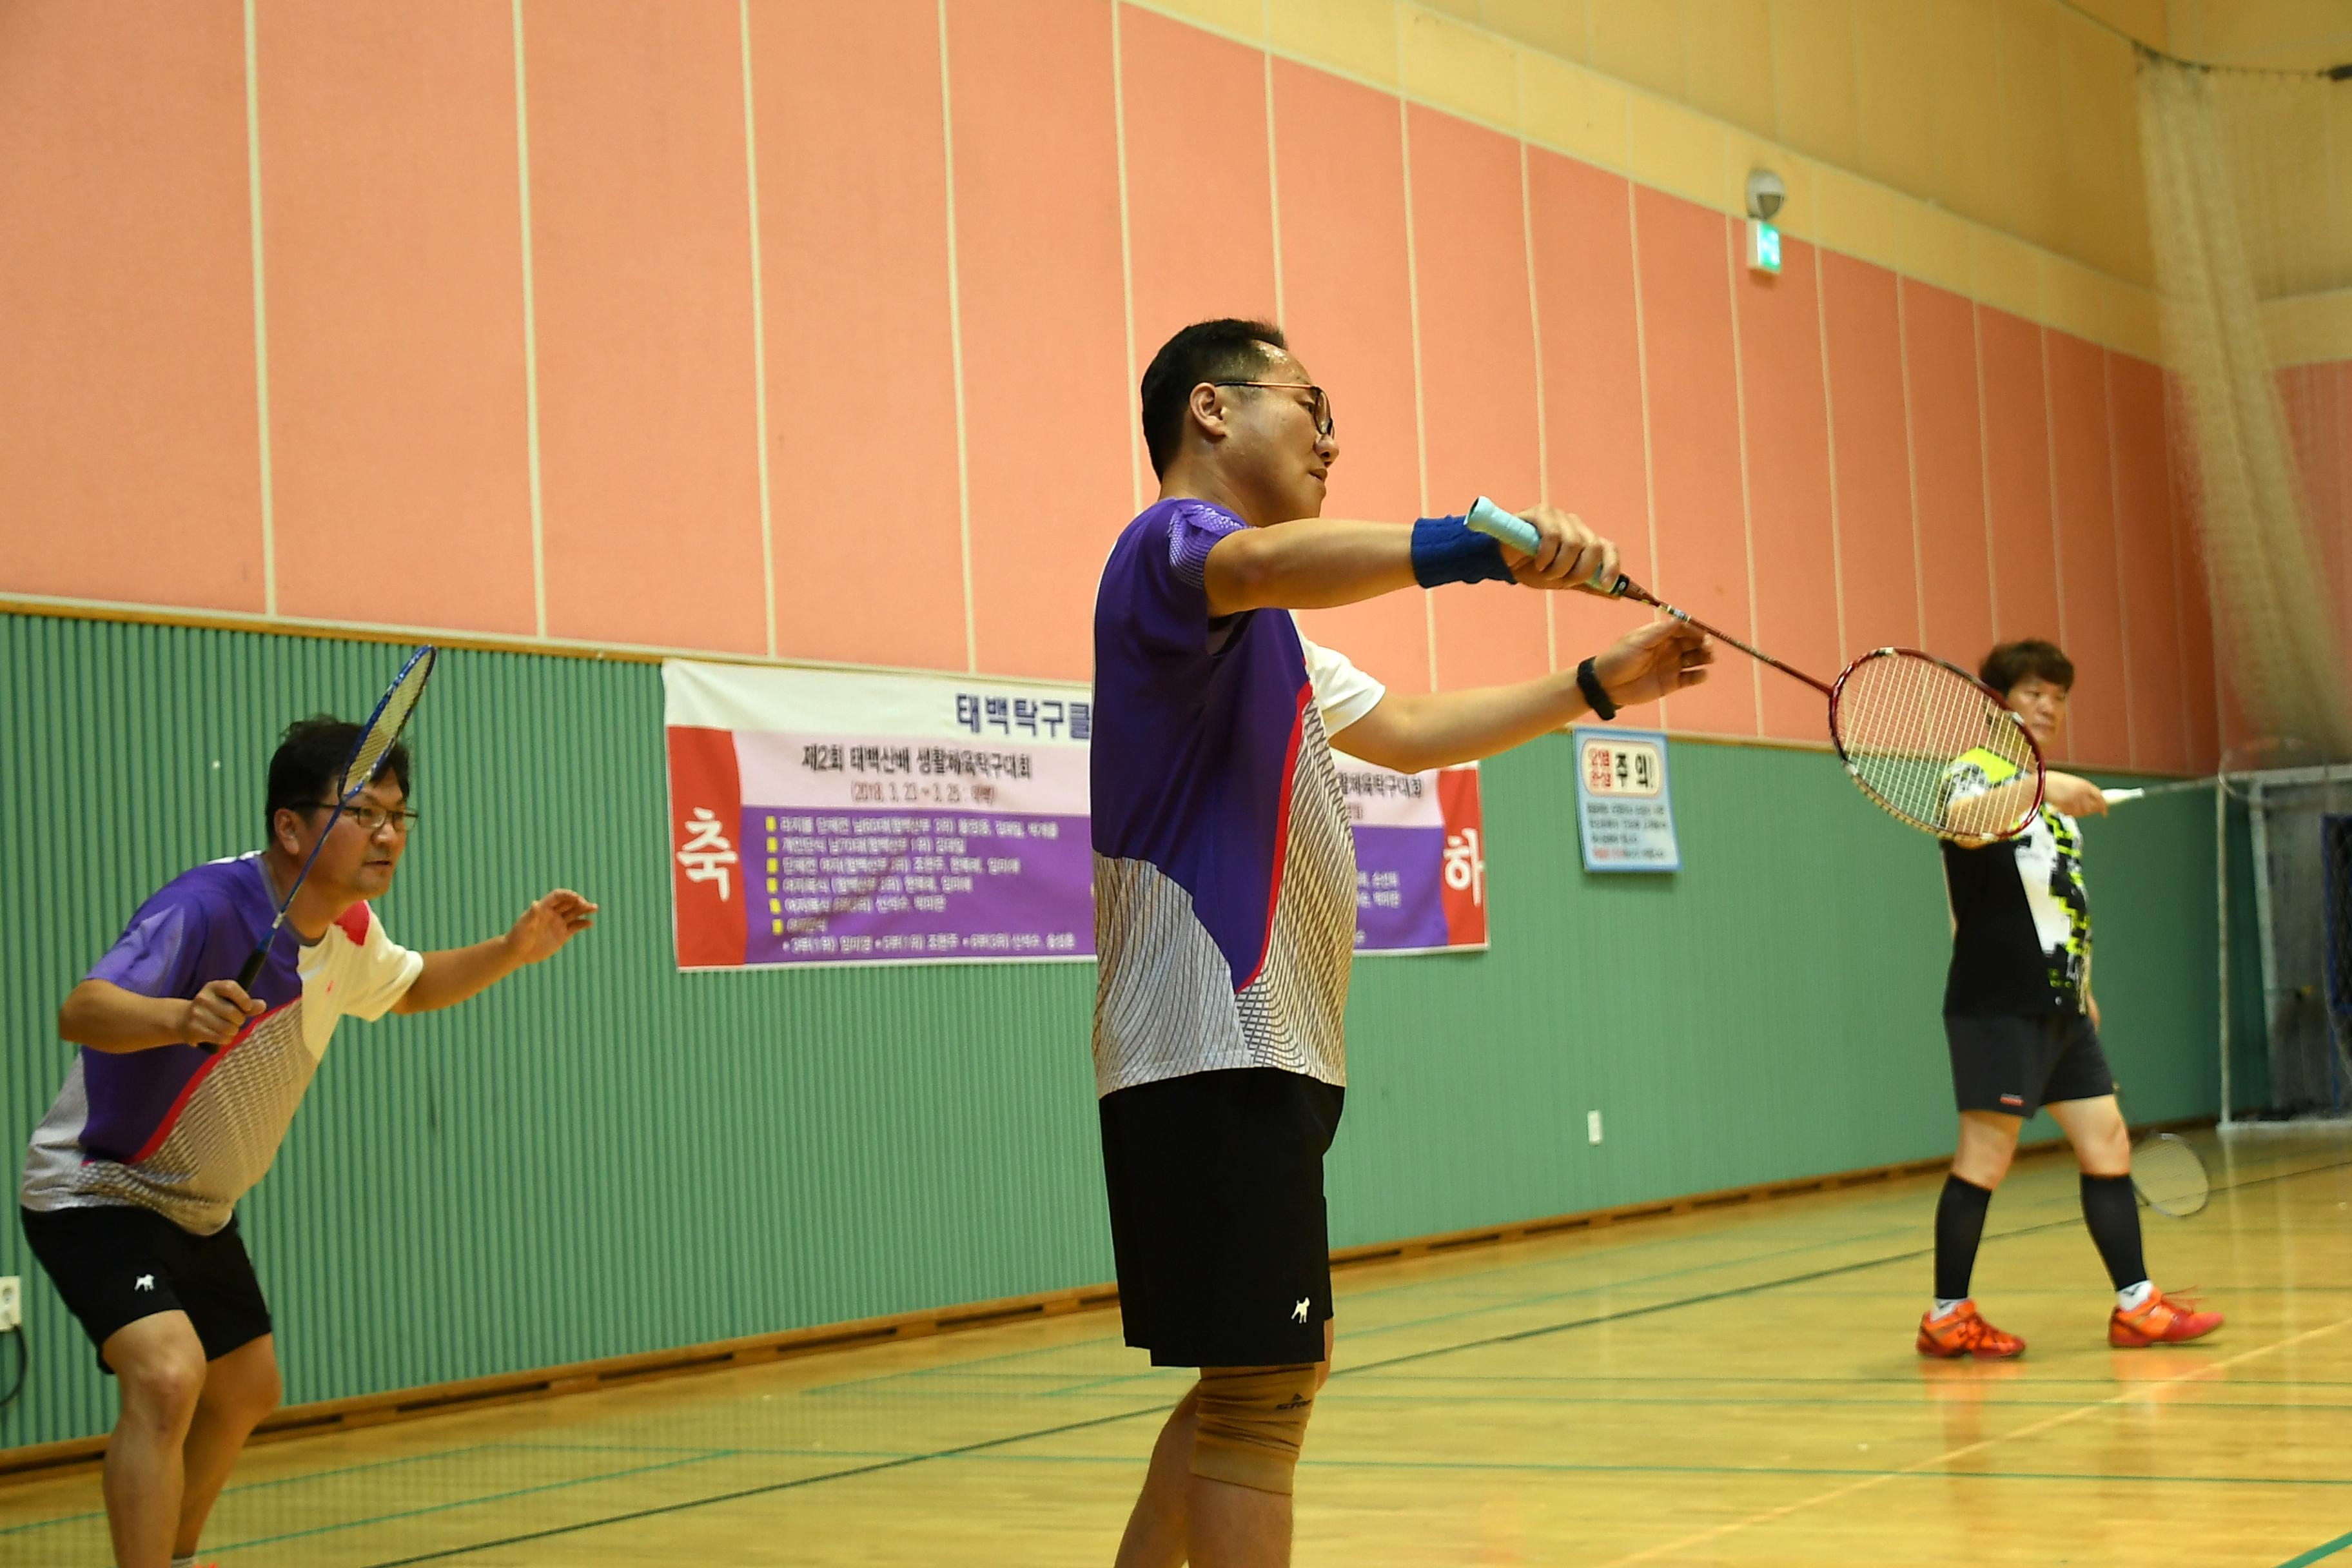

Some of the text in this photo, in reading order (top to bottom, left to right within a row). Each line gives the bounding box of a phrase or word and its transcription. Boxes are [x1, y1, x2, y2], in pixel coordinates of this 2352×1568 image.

[802, 743, 1032, 779] 제2회 태백산배 생활체육탁구대회
[677, 807, 738, 902] 축
[1444, 827, 1485, 908] 하
